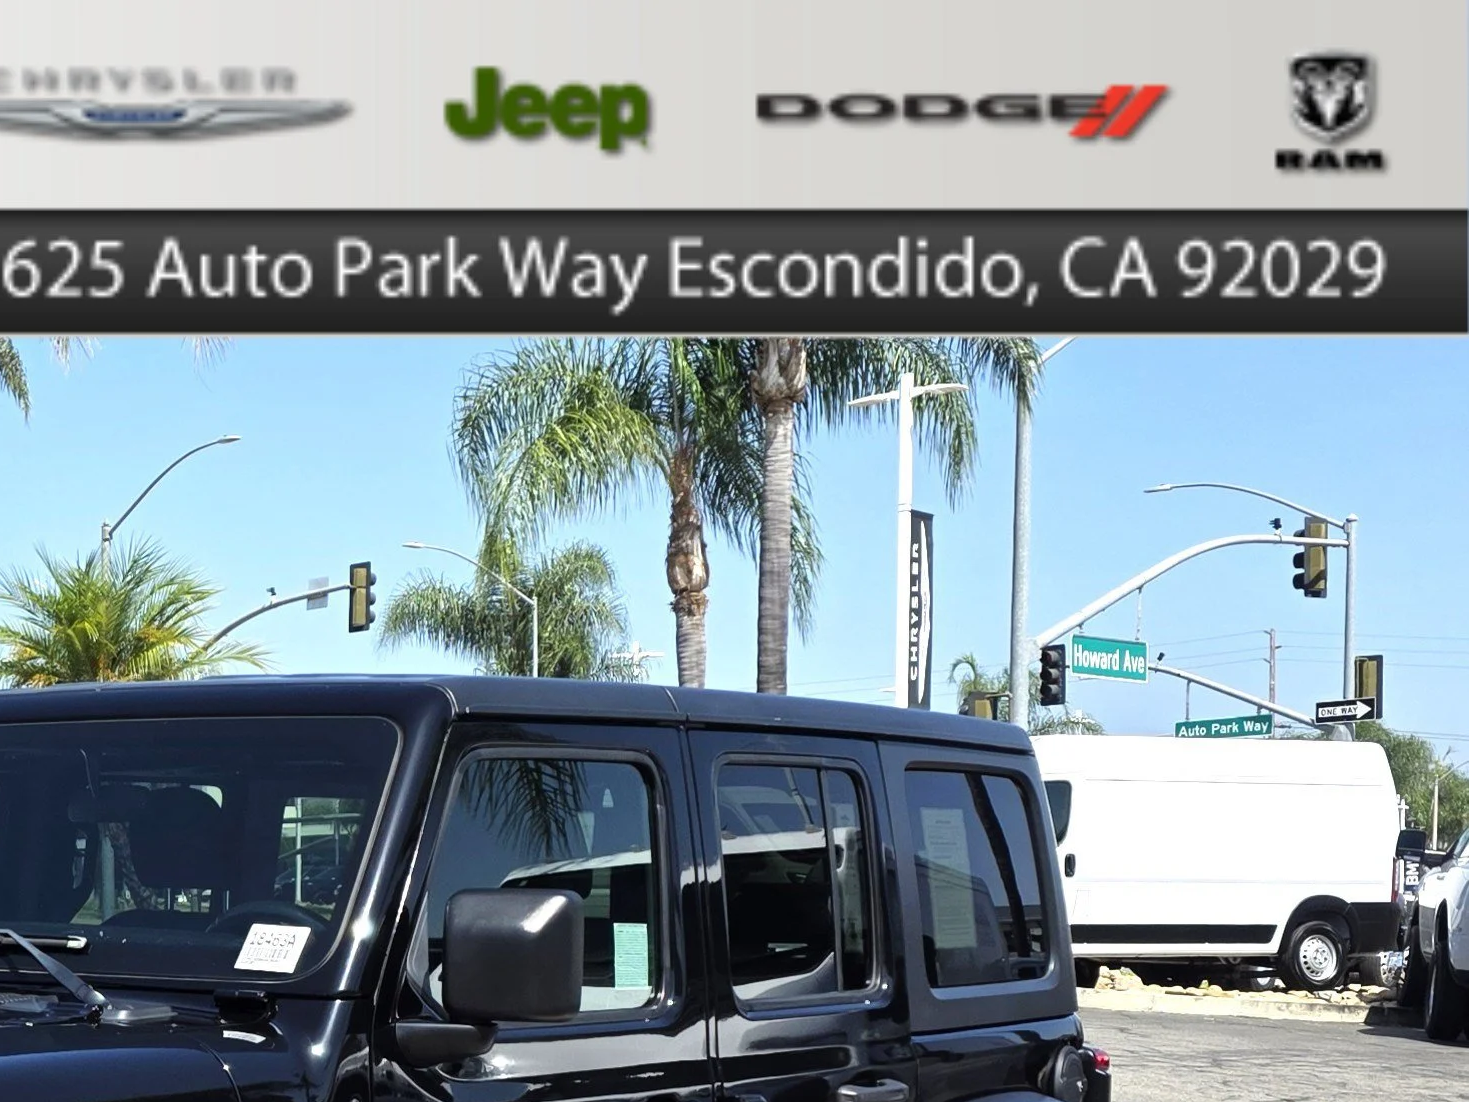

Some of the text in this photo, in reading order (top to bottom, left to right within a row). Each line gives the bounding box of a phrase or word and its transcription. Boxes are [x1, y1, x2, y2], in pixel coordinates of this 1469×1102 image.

[910, 543, 919, 681] CHRYSLER
[1074, 643, 1145, 674] Howard Ave
[1321, 706, 1358, 717] ONE WAY
[1179, 720, 1269, 737] Auto Park Way
